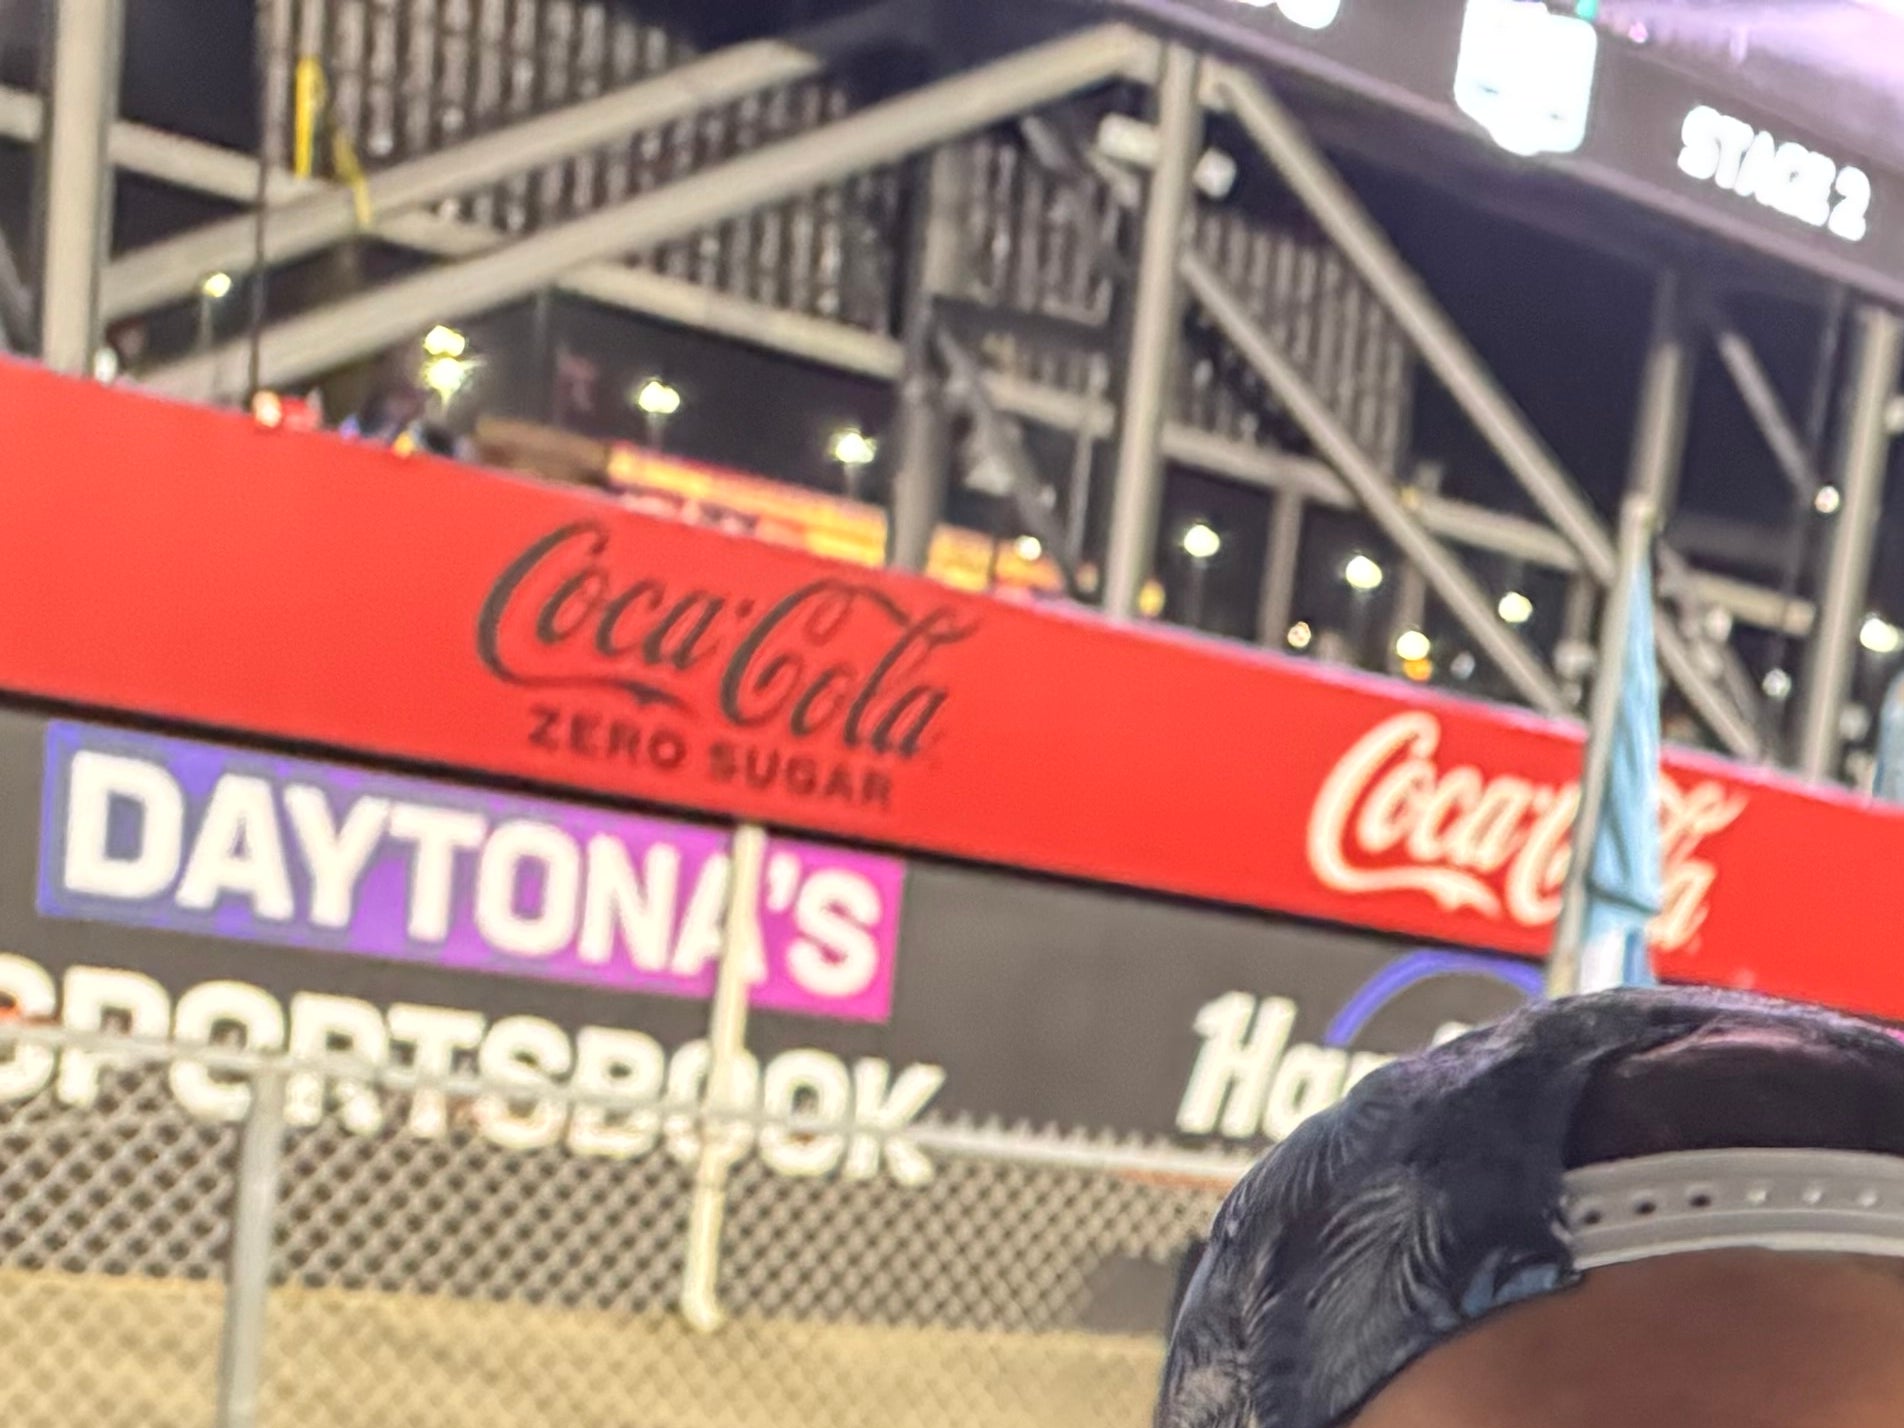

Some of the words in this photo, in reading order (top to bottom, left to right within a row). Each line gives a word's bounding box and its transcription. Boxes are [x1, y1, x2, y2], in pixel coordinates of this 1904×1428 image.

[1677, 105, 1837, 227] STAGE
[1828, 165, 1871, 241] 2
[476, 518, 980, 760] Coca-Cola
[528, 704, 687, 770] ZERO
[708, 739, 896, 807] SUGAR
[62, 750, 883, 998] DAYTONA'S
